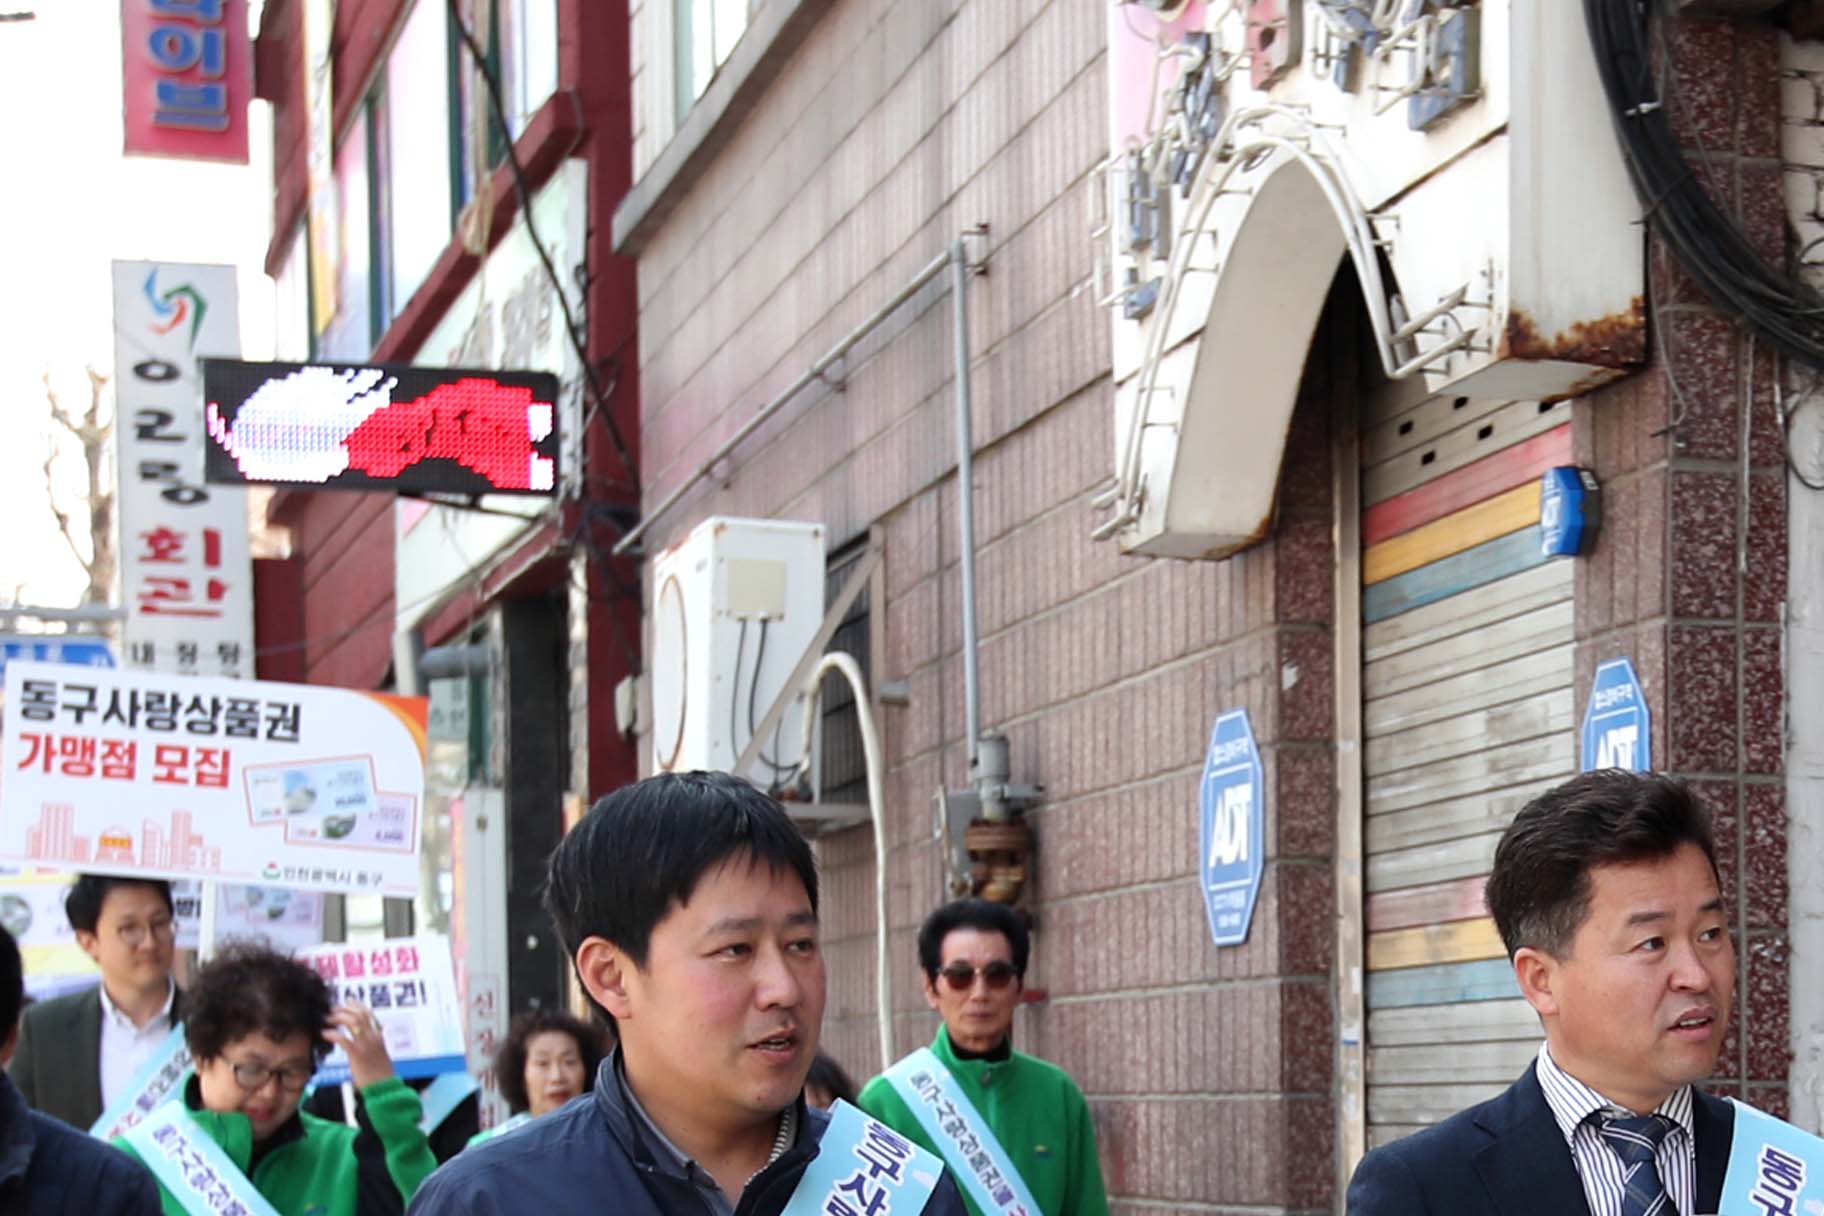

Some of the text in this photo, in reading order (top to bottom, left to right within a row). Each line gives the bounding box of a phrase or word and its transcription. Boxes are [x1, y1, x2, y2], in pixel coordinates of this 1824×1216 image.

[147, 0, 230, 132] 이브
[19, 679, 303, 743] 동구사랑상품권
[17, 732, 138, 781] 가맹점
[152, 744, 232, 789] 모집
[1209, 783, 1252, 868] ADT
